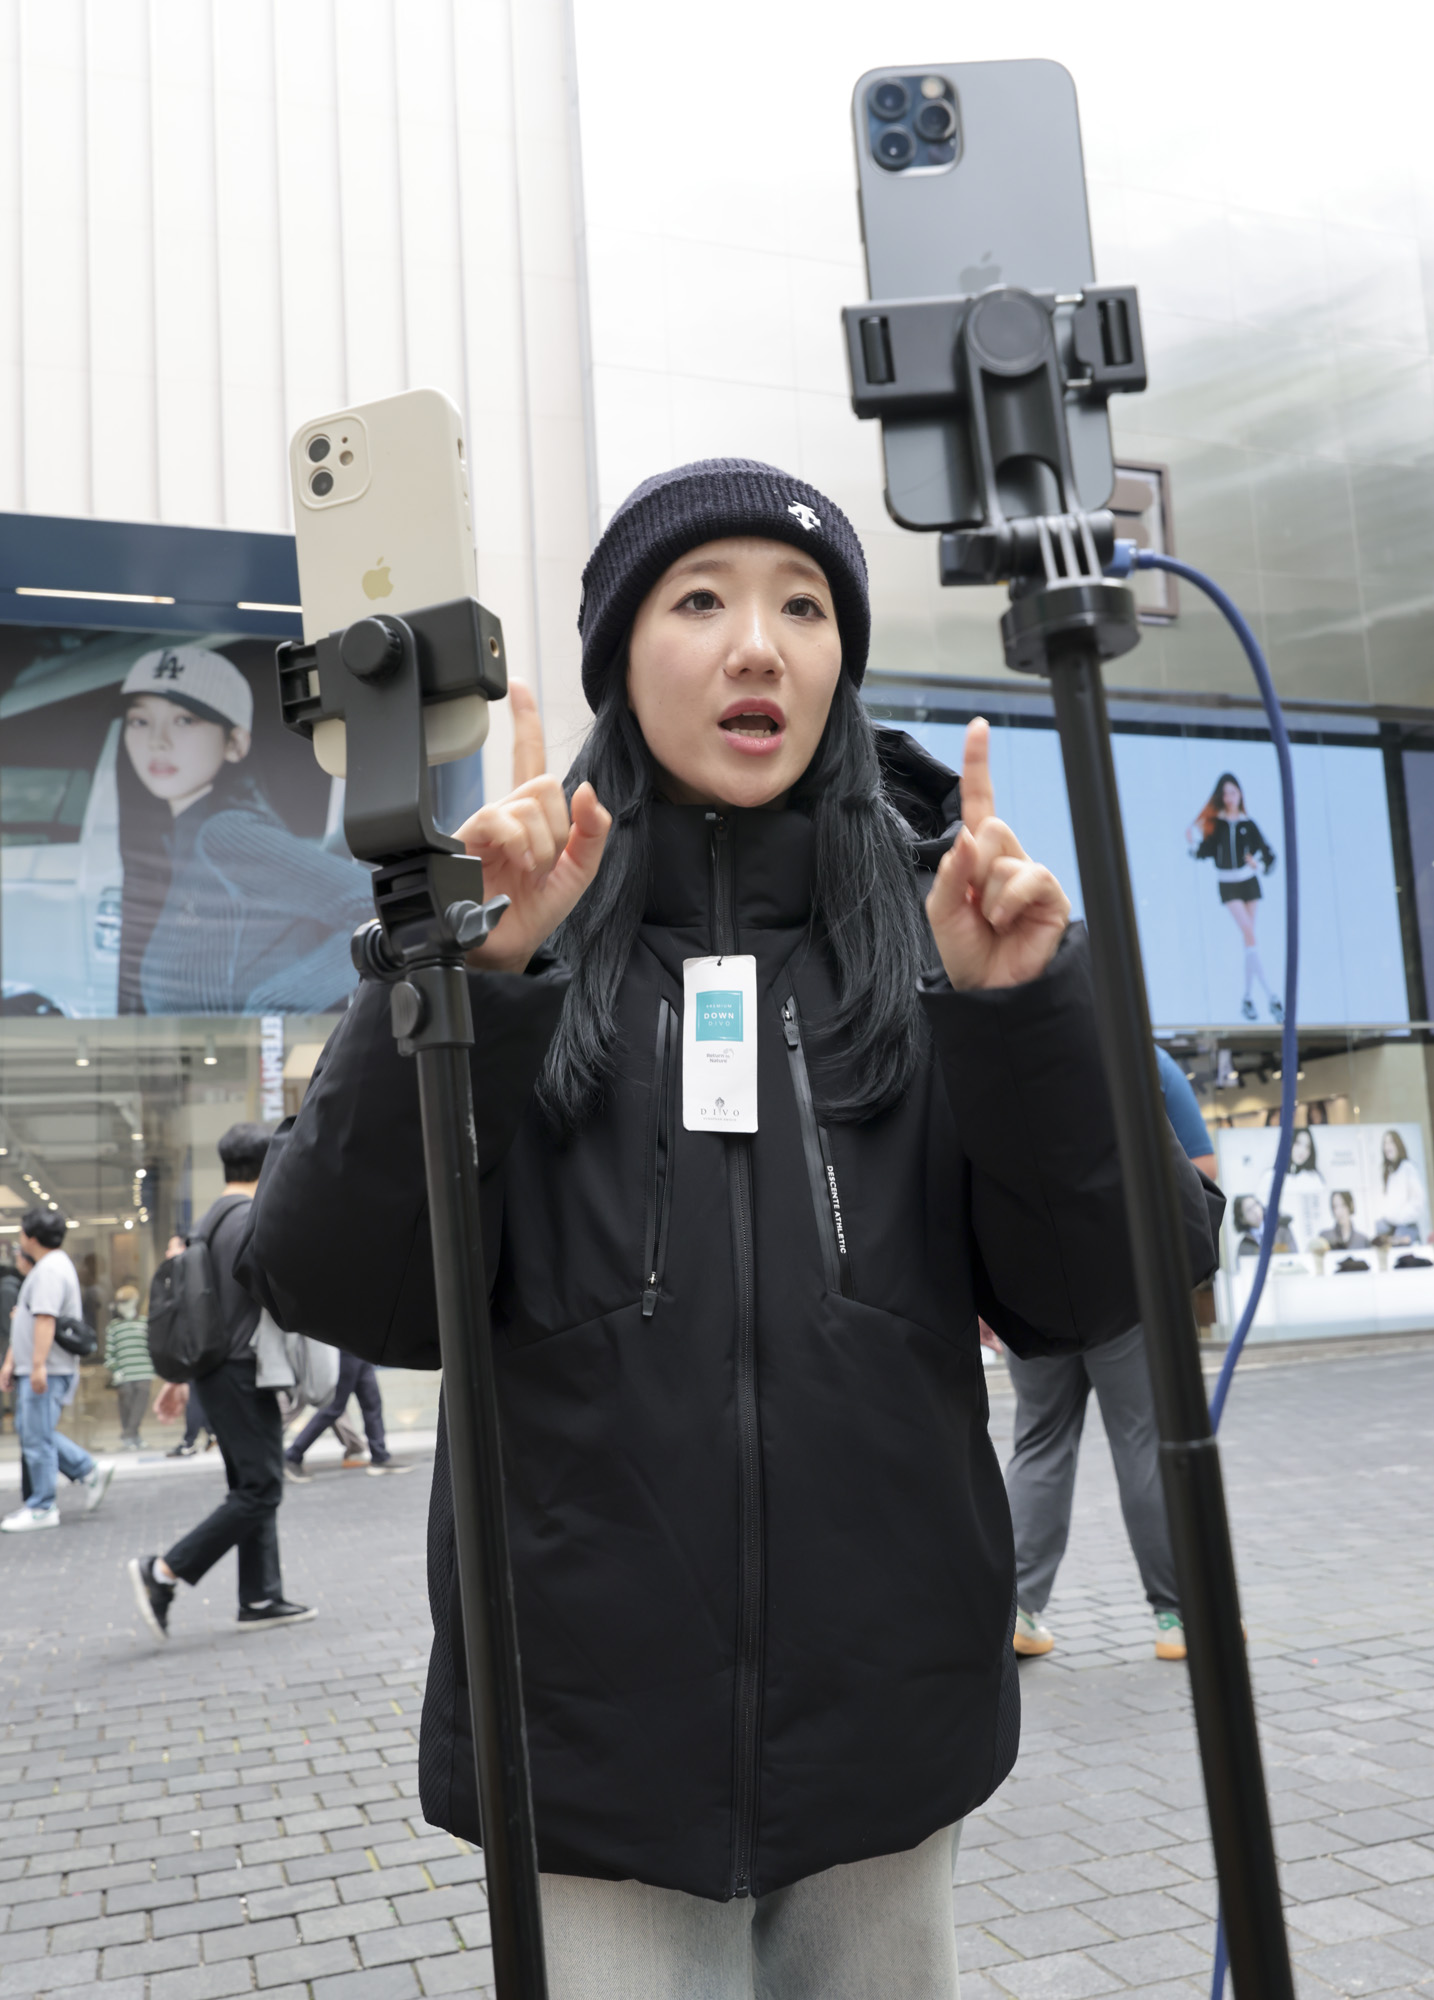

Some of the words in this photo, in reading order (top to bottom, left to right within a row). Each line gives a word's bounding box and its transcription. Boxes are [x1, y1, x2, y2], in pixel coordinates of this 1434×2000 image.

[153, 649, 185, 680] LA
[703, 1012, 734, 1020] DOWN
[700, 1108, 740, 1117] DIVO
[826, 1165, 841, 1210] DESCENTE
[834, 1211, 847, 1254] ATHLETIC
